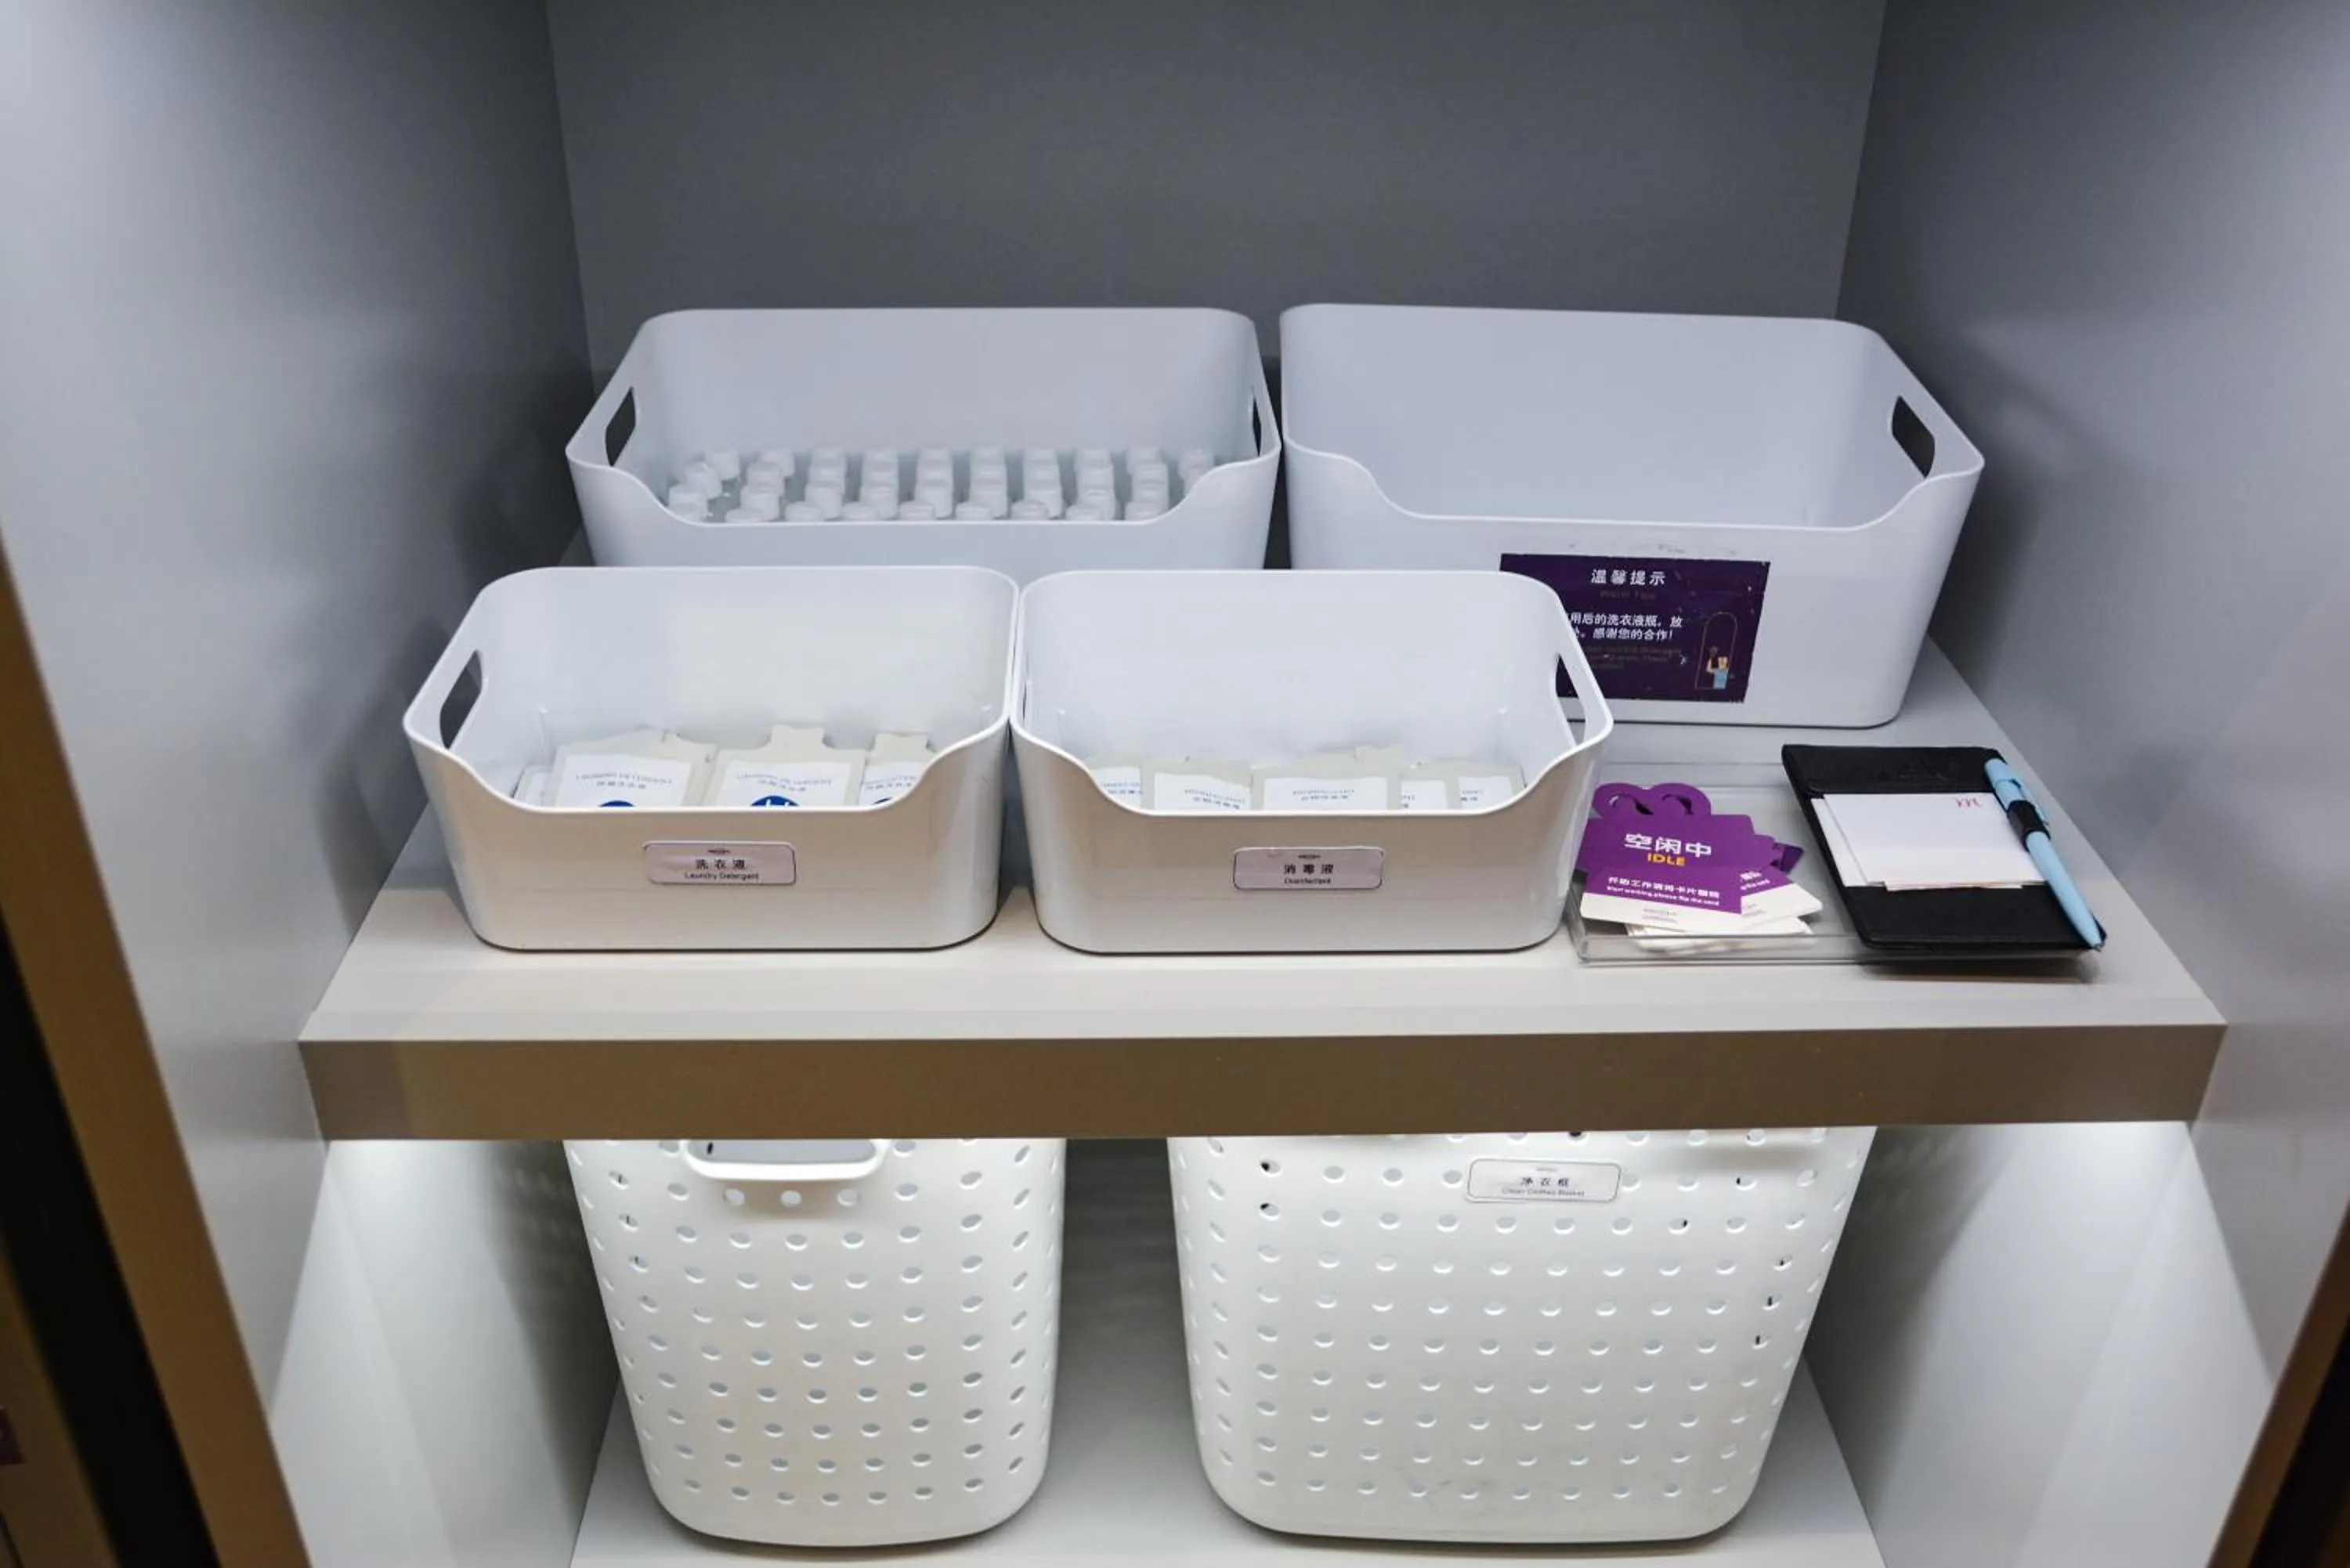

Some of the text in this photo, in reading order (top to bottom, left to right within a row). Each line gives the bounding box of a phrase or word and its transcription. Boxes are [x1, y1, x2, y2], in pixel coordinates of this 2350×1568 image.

[1591, 569, 1666, 586] 温馨提示
[1624, 833, 1712, 858] 空闲中
[1647, 852, 1685, 867] IDLE
